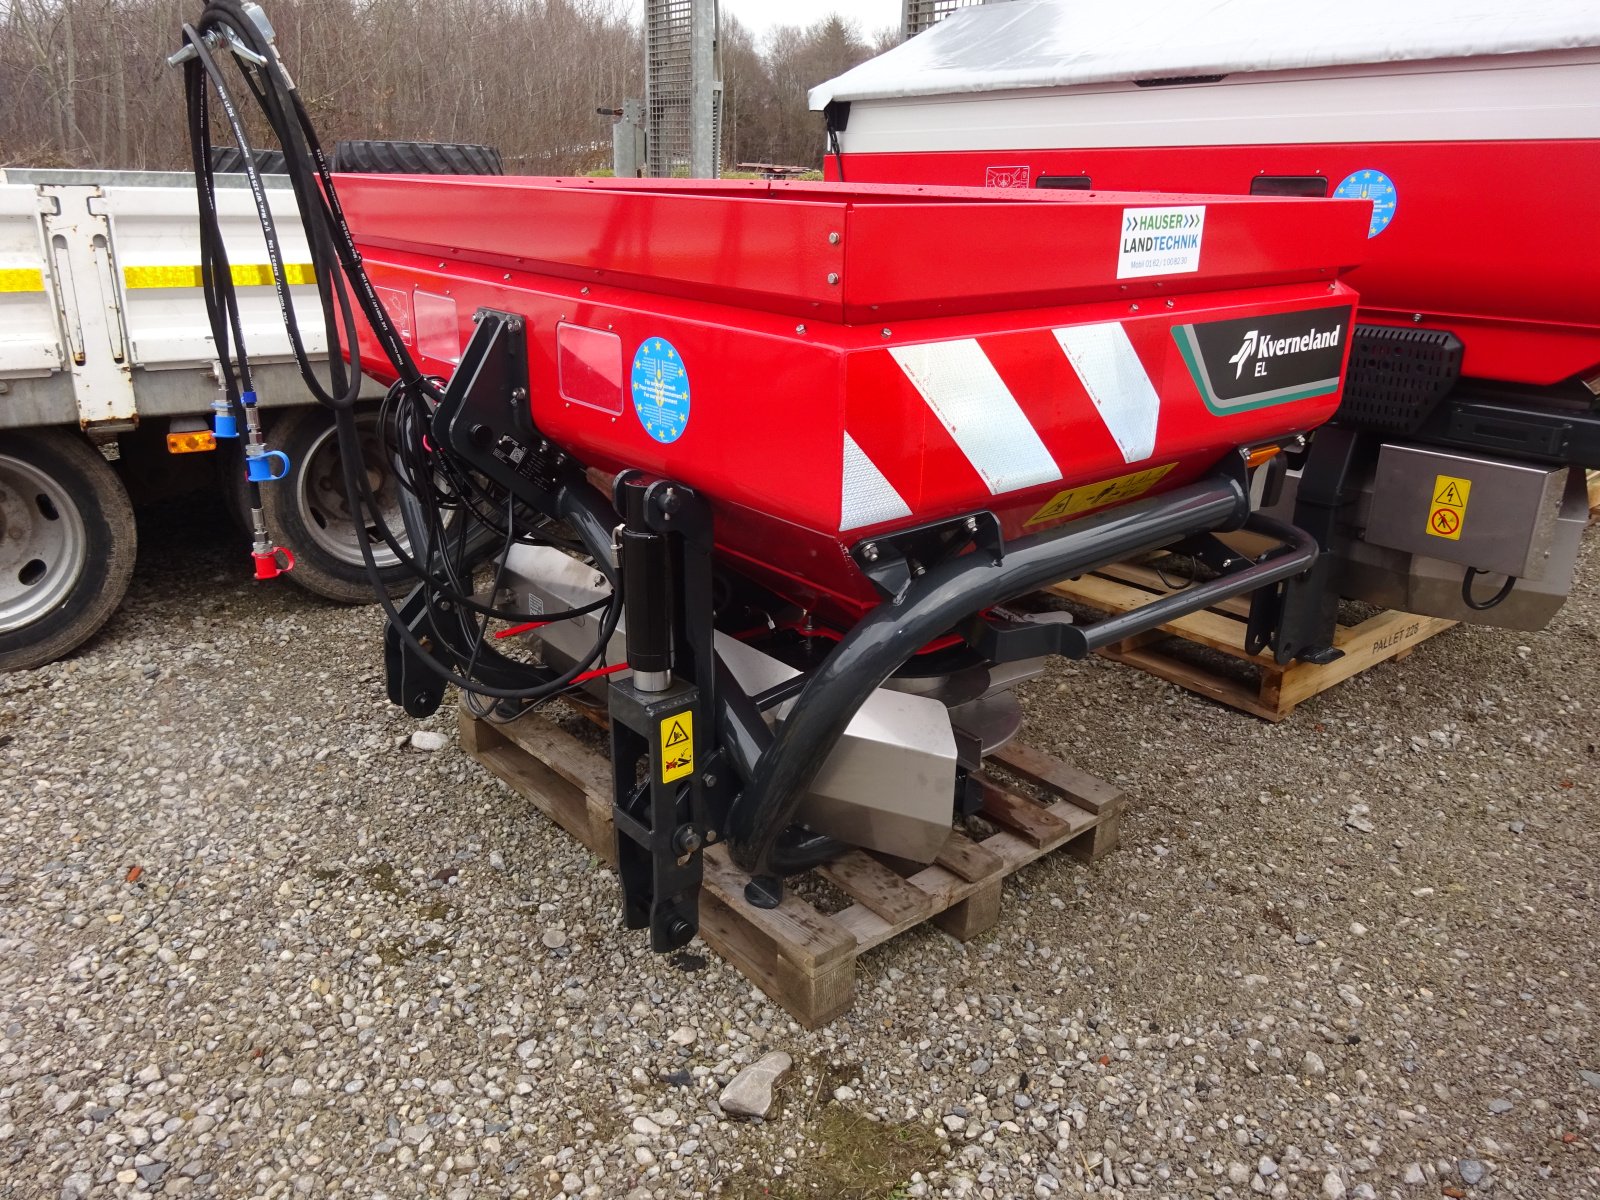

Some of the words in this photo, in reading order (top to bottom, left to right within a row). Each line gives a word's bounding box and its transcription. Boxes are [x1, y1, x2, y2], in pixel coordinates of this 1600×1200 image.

[1139, 213, 1183, 231] HAUSER
[1123, 233, 1198, 254] LANDTECHNIK
[1257, 324, 1341, 359] Kverneland
[1254, 361, 1268, 377] EL
[1372, 629, 1405, 654] PALLET
